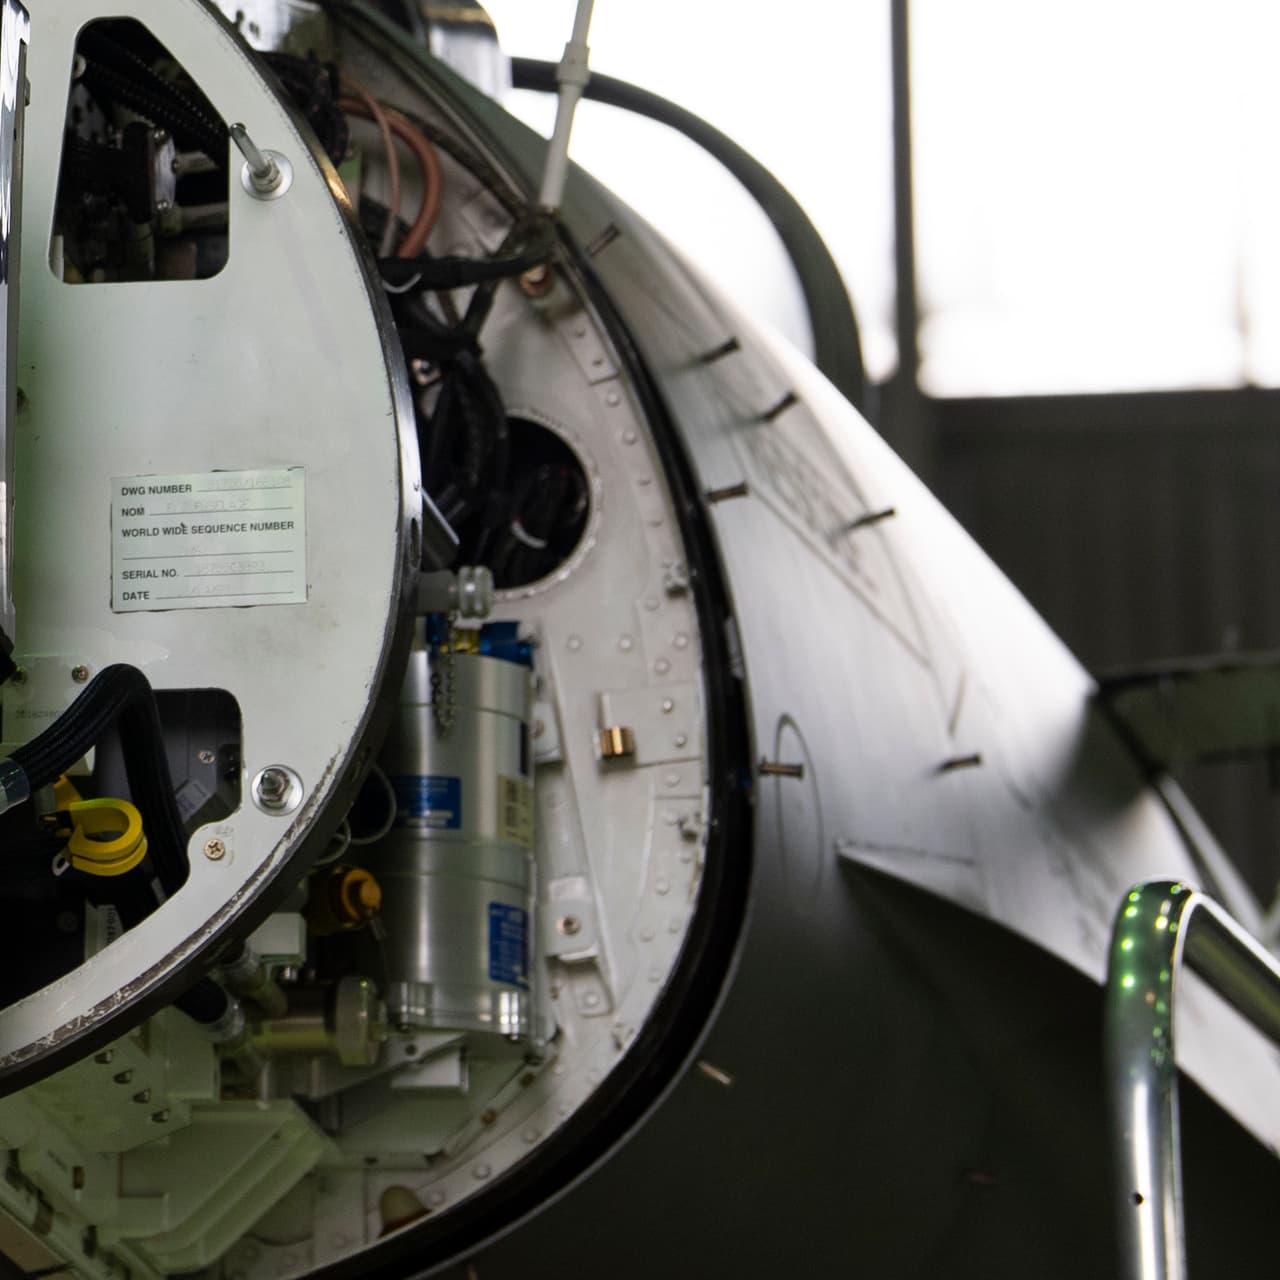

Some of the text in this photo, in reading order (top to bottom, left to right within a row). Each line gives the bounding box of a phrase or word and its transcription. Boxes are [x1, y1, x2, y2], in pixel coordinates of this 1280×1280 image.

[121, 484, 192, 496] DWG NUMBER
[121, 507, 145, 517] NOM
[121, 521, 294, 538] WORLD WIDE SEQUENCE NUMBER
[122, 570, 159, 580] SERIAL
[122, 591, 149, 601] DATE
